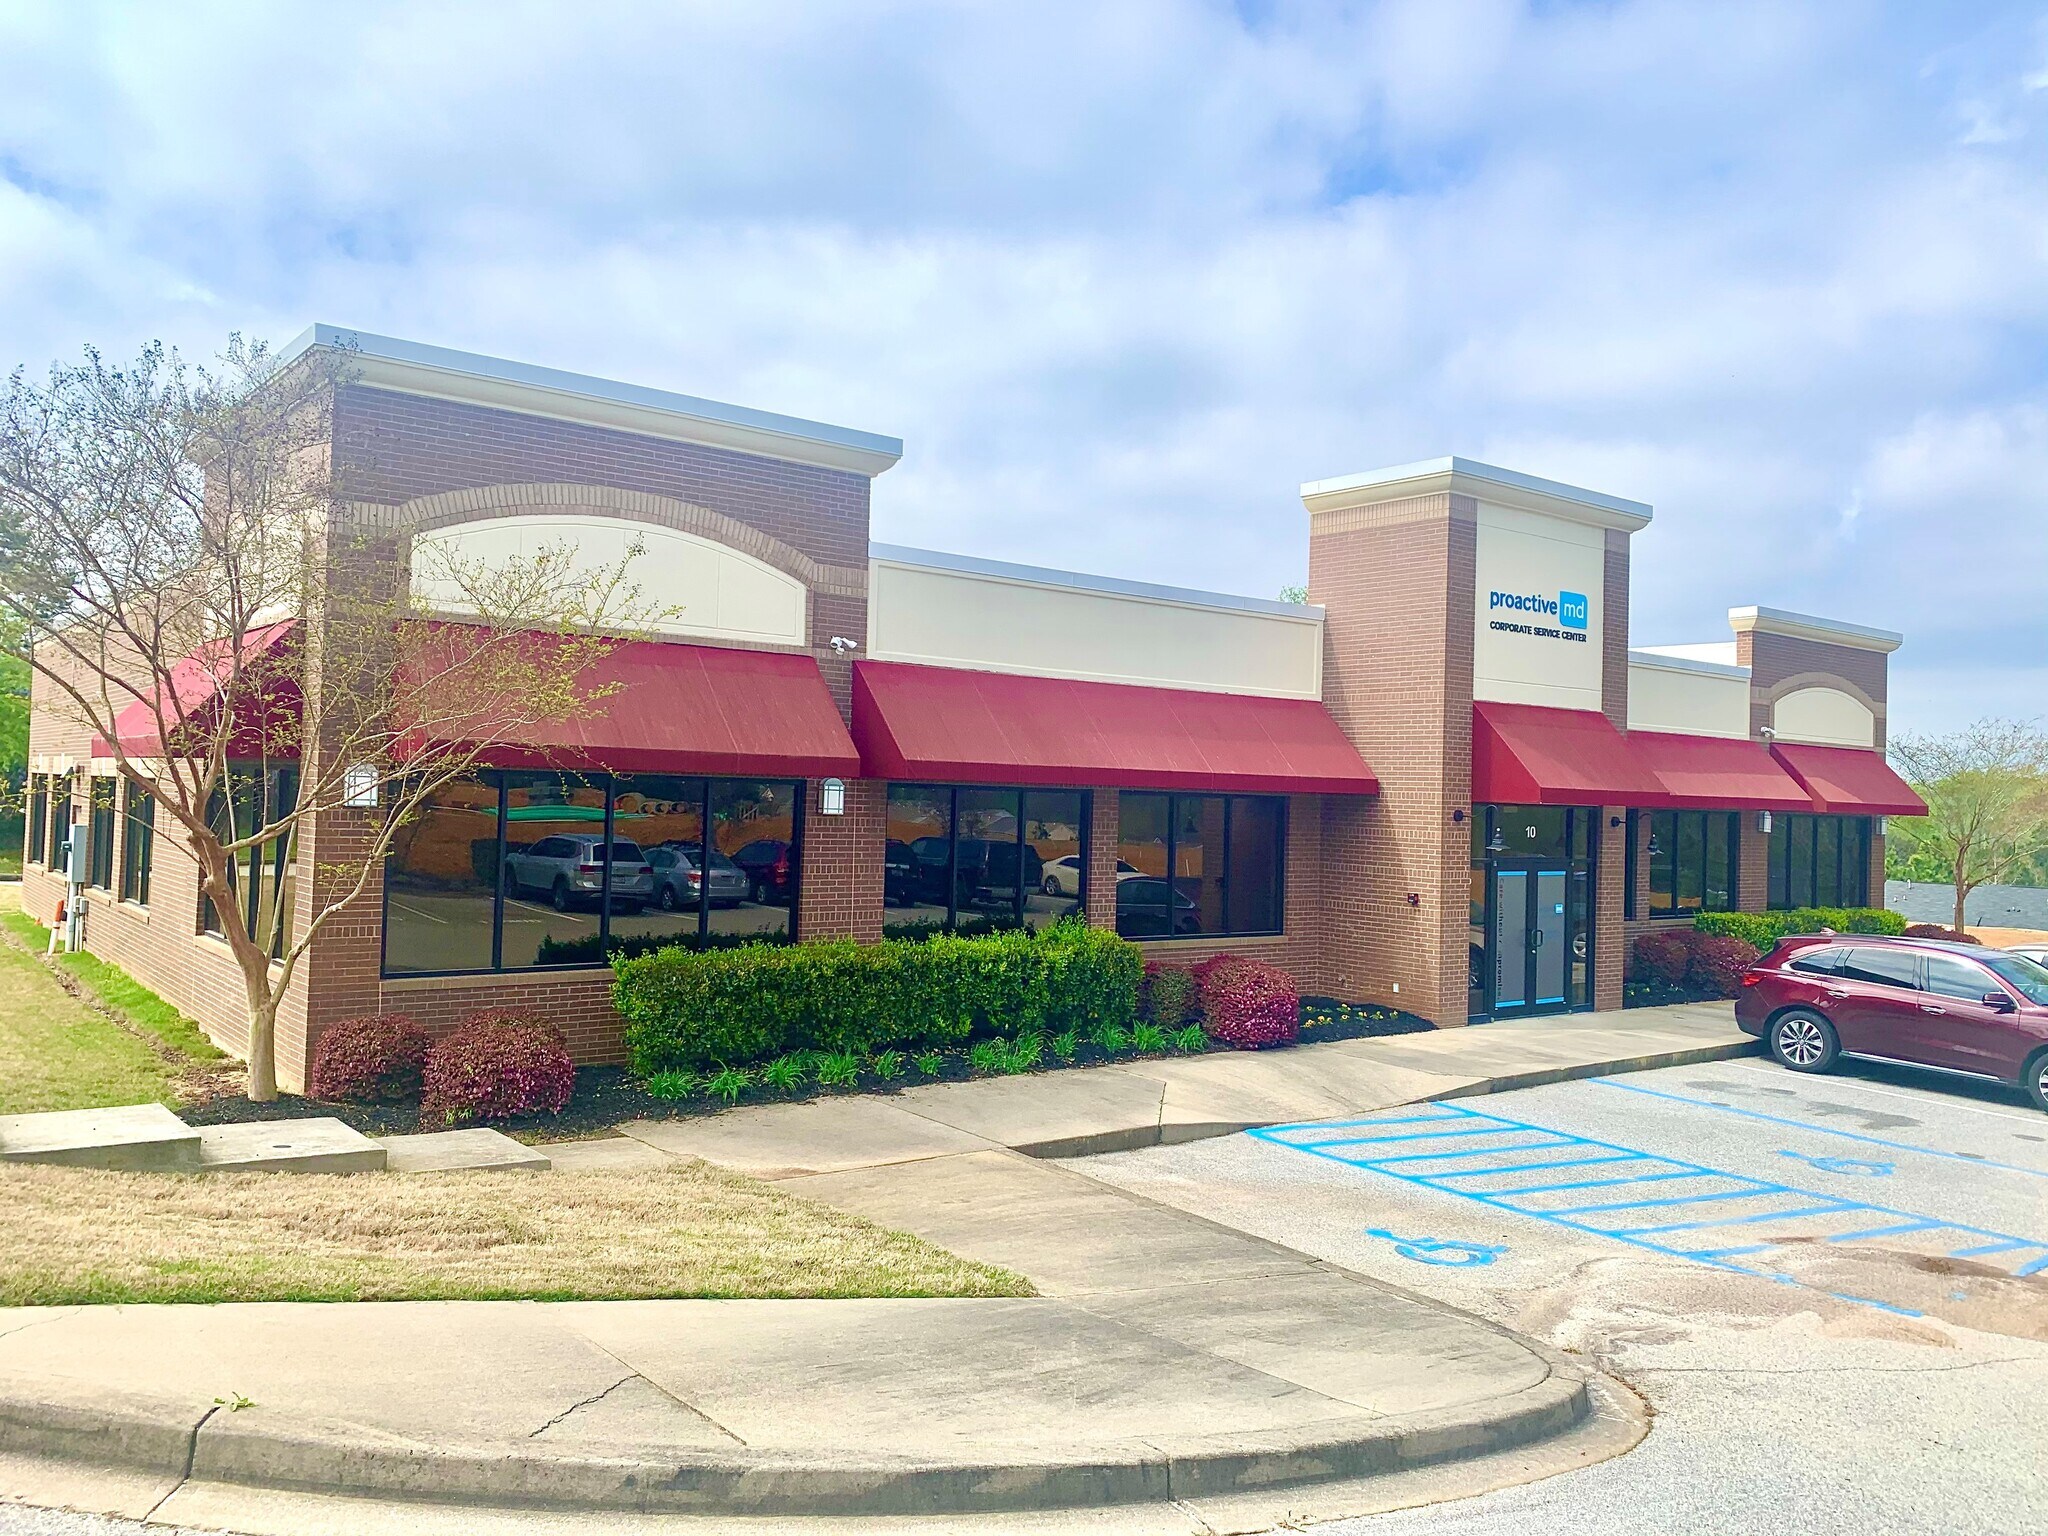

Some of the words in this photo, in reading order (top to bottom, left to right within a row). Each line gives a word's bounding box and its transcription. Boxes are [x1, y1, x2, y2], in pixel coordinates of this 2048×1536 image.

[1490, 591, 1557, 615] proactive
[1564, 602, 1584, 619] md
[1490, 621, 1532, 635] CORPORATE
[1533, 627, 1560, 639] SERVICE
[1562, 631, 1586, 642] CENTER
[1525, 826, 1536, 838] 10
